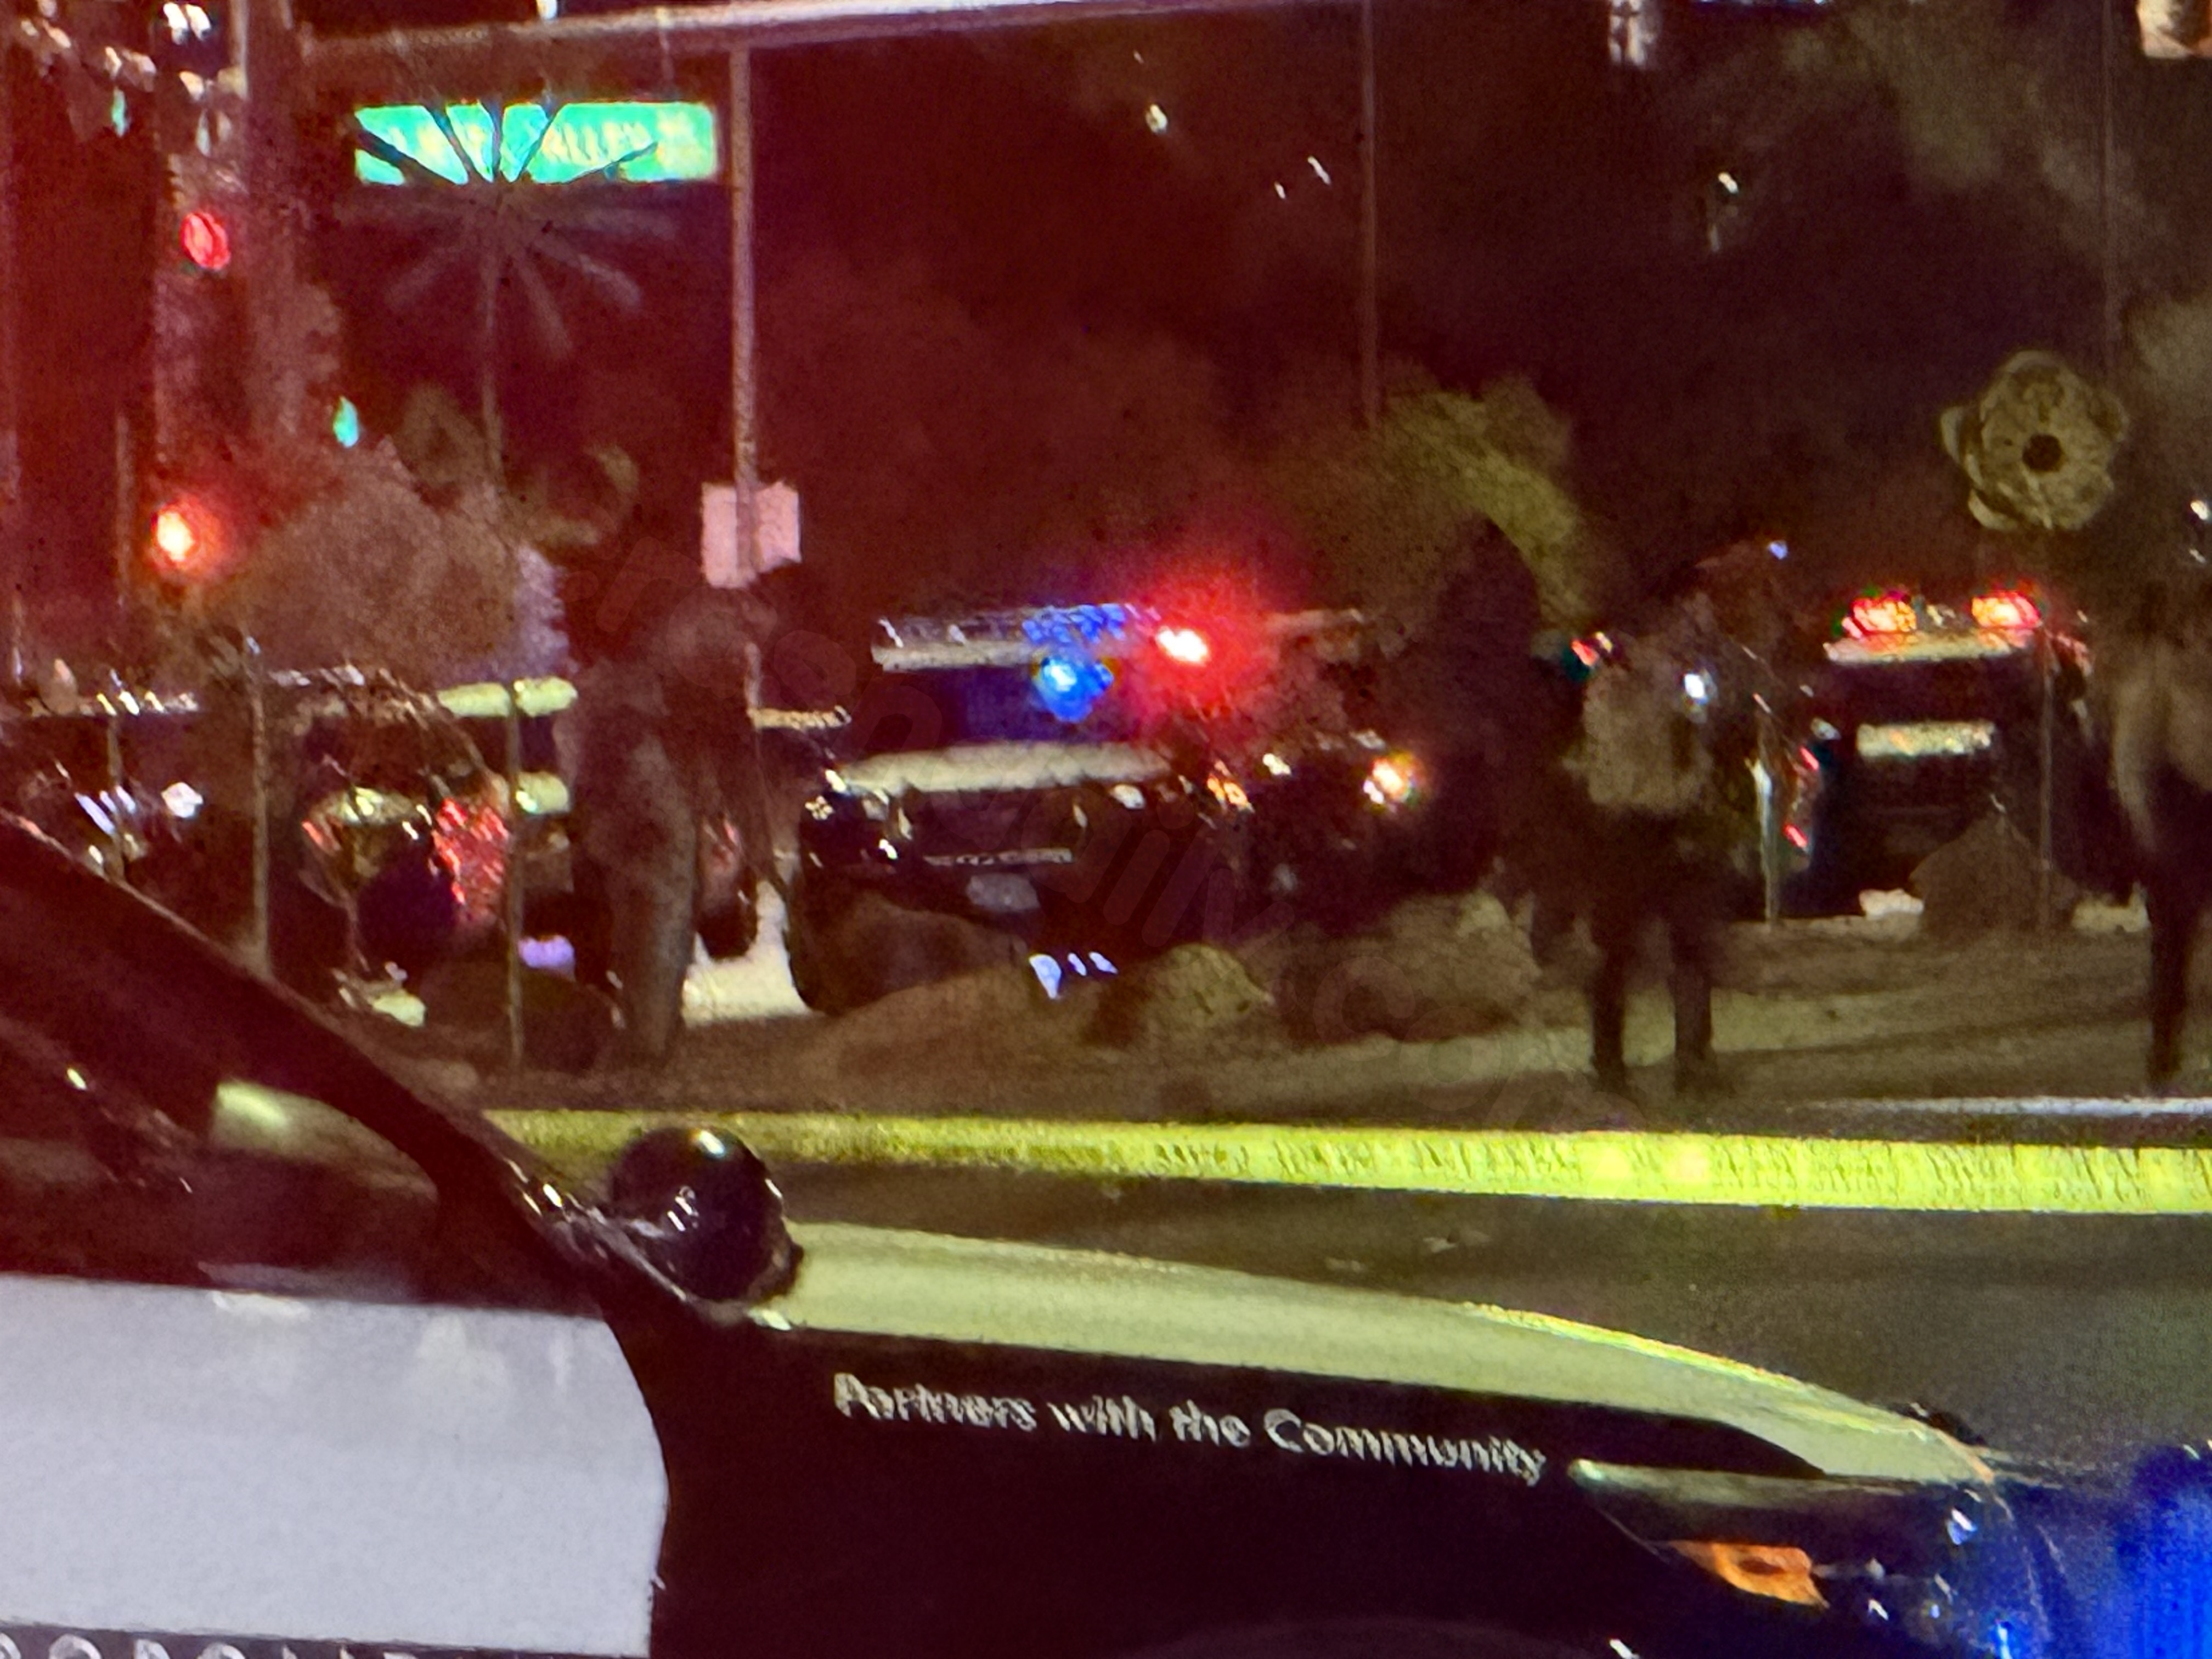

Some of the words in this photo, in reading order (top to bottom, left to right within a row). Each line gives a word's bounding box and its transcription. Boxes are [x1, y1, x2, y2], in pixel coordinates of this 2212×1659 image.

[834, 1373, 1037, 1432] Partners
[1046, 1395, 1156, 1442] with
[1169, 1399, 1251, 1448] the
[1263, 1408, 1547, 1487] Community
